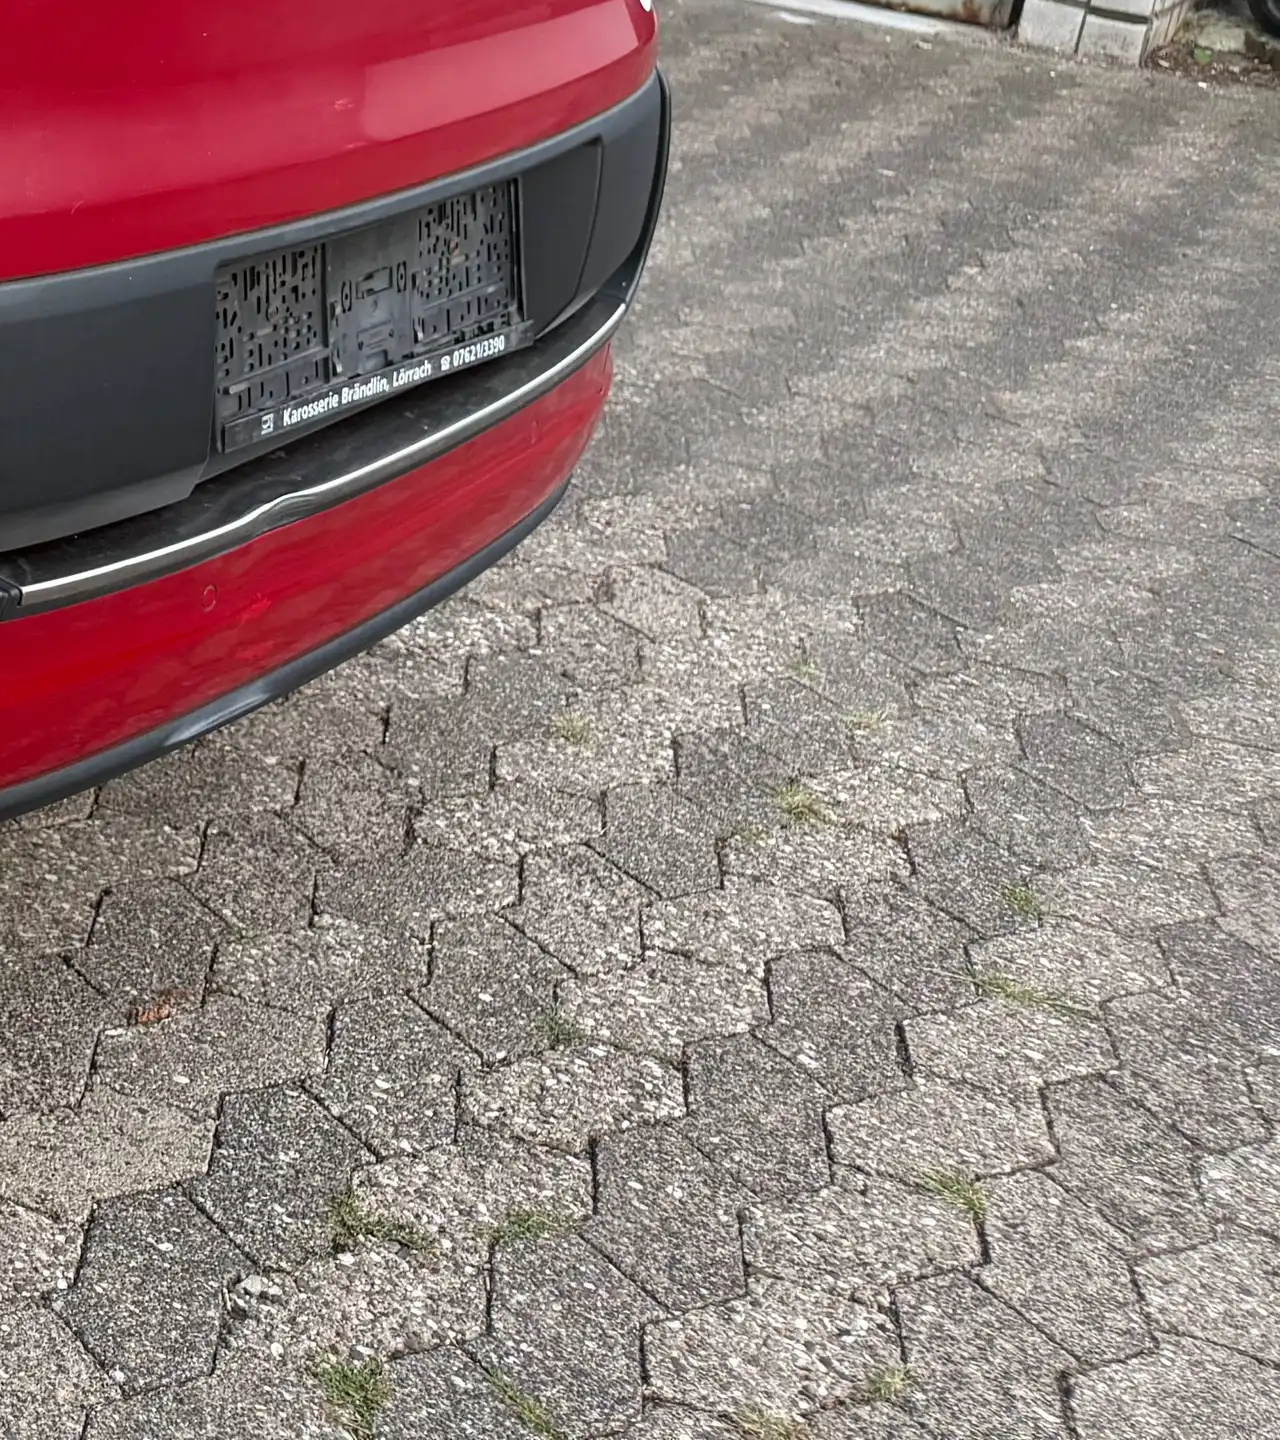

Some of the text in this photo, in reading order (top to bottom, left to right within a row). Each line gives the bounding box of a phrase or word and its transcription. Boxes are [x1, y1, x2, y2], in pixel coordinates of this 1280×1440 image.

[282, 394, 339, 427] Karosserie
[341, 377, 390, 406] Brändlin,
[392, 360, 432, 388] Lörrach
